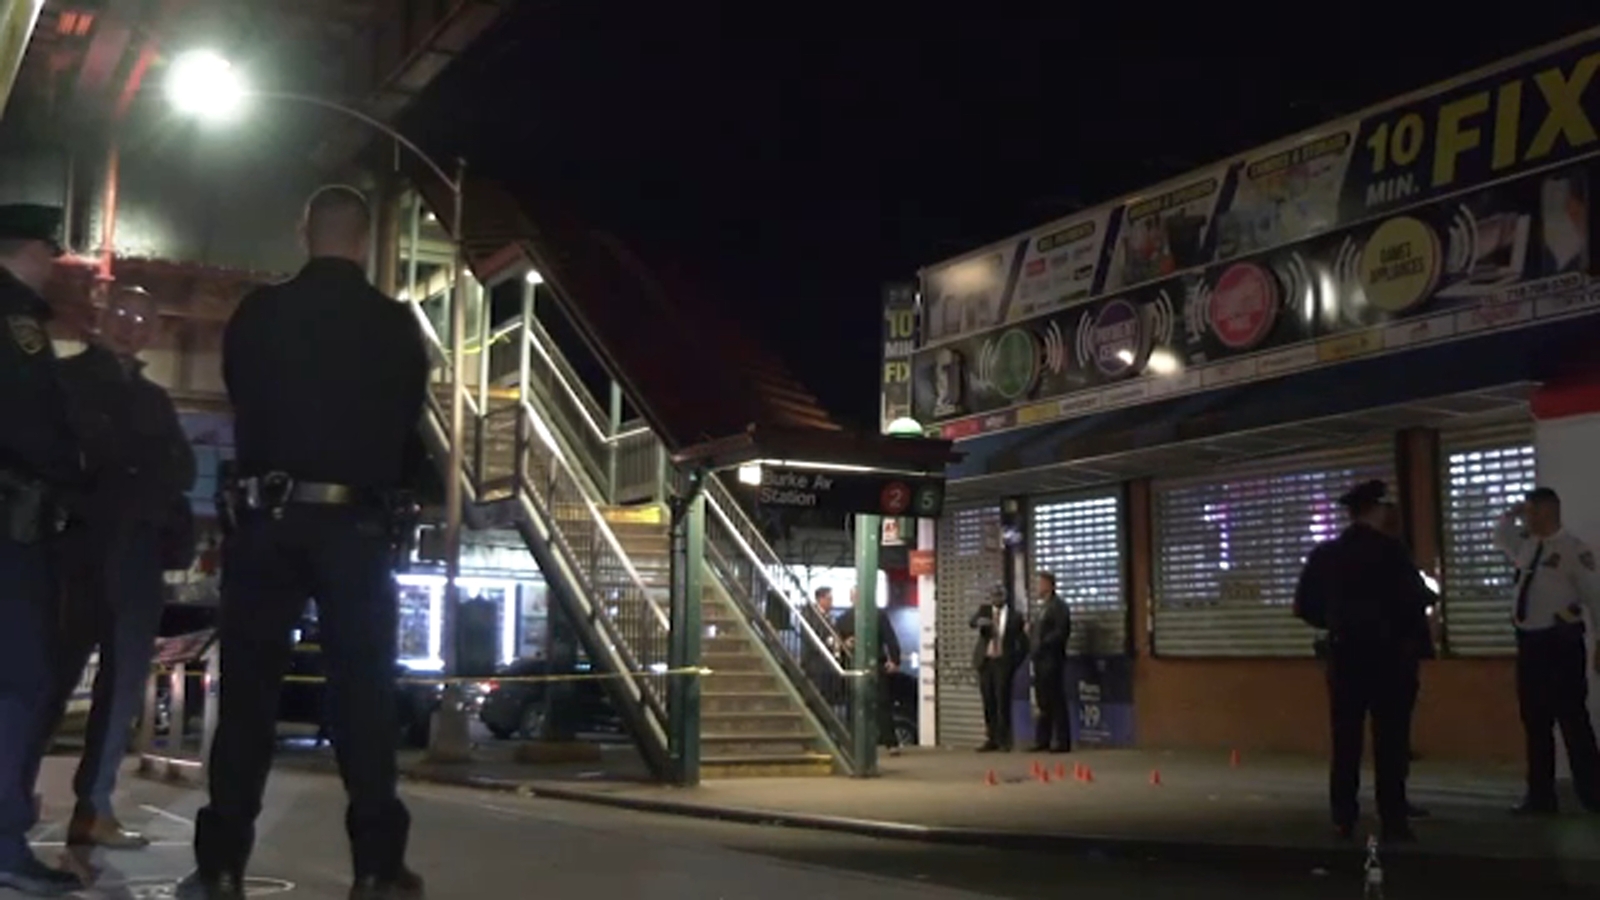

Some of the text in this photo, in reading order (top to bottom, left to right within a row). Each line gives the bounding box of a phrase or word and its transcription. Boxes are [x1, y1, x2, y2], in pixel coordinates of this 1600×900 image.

[1366, 111, 1424, 174] 10
[1431, 51, 1600, 188] FIX
[886, 309, 914, 339] 10
[760, 486, 817, 507] Station
[763, 469, 934, 510] Burke Av 2 5
